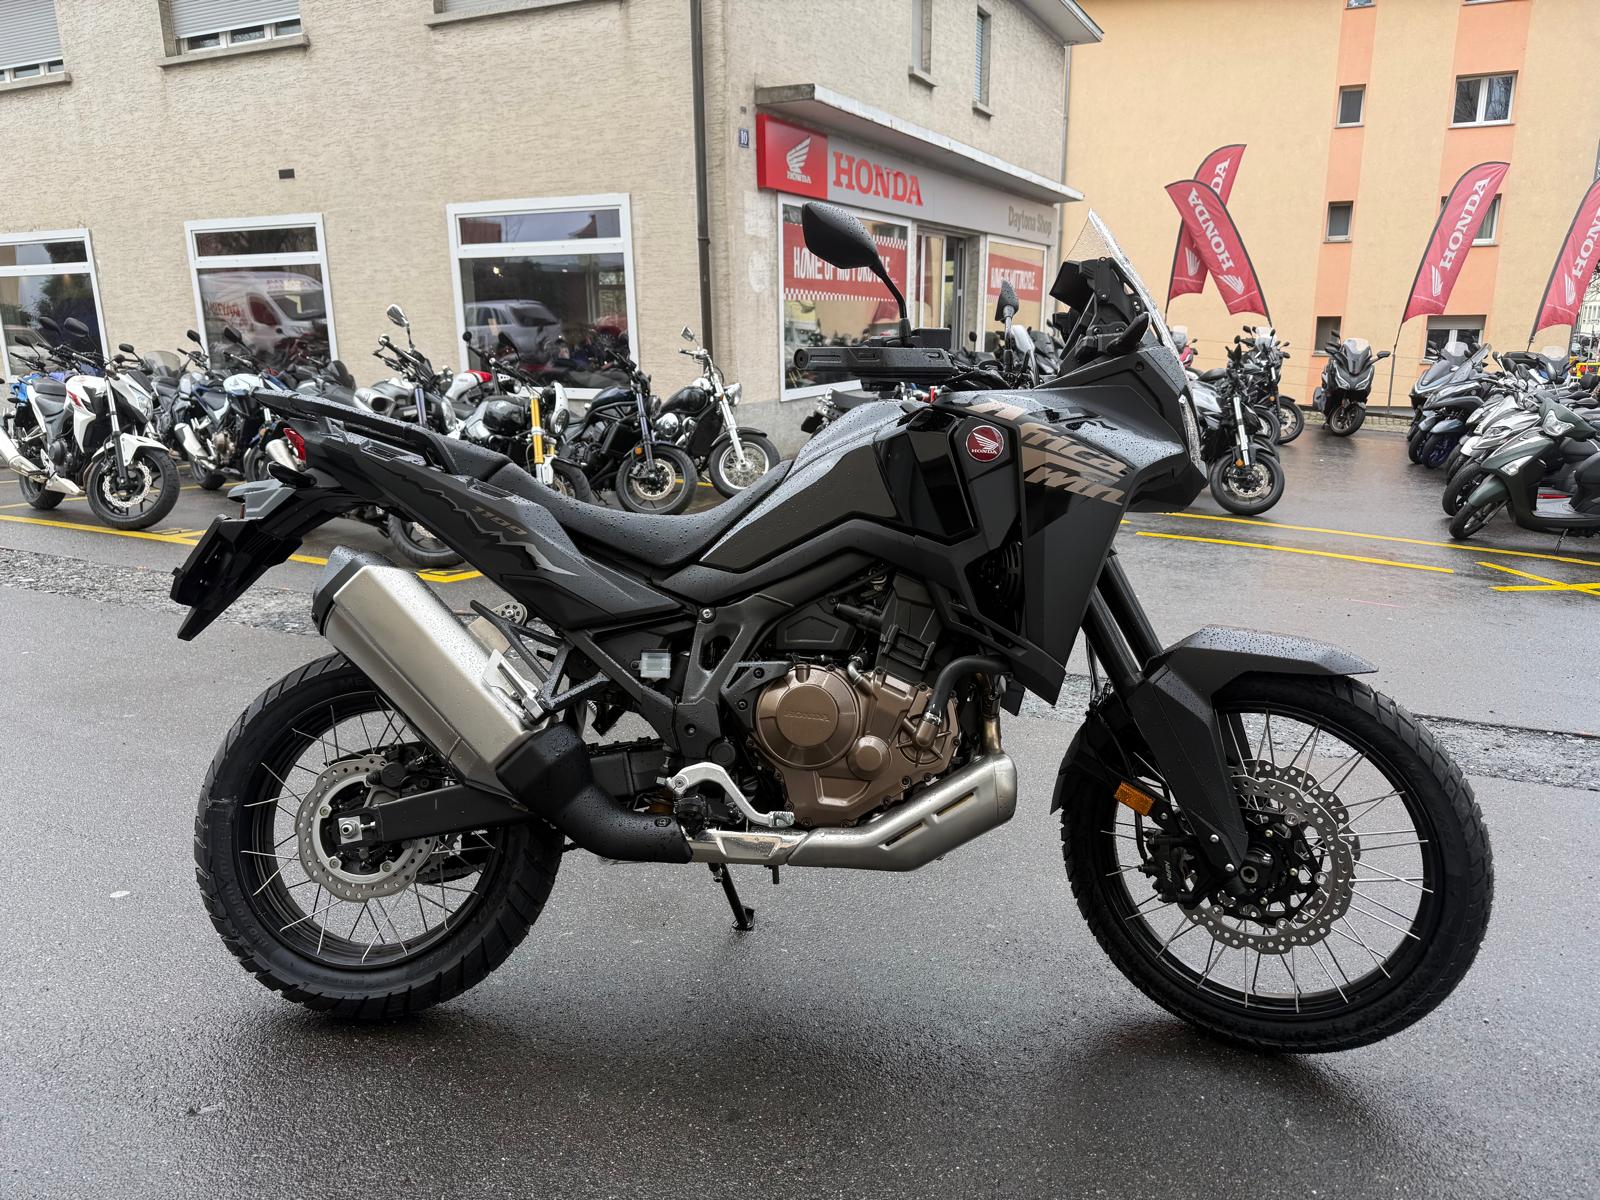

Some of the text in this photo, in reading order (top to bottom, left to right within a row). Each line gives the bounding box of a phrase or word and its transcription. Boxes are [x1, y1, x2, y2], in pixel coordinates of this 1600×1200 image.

[786, 171, 813, 184] HONDA
[833, 151, 924, 207] HONDA
[1008, 205, 1052, 239] Daytona Shop
[1187, 187, 1235, 271] HONDA
[1439, 177, 1491, 271] HONDA
[793, 246, 823, 280] HOME
